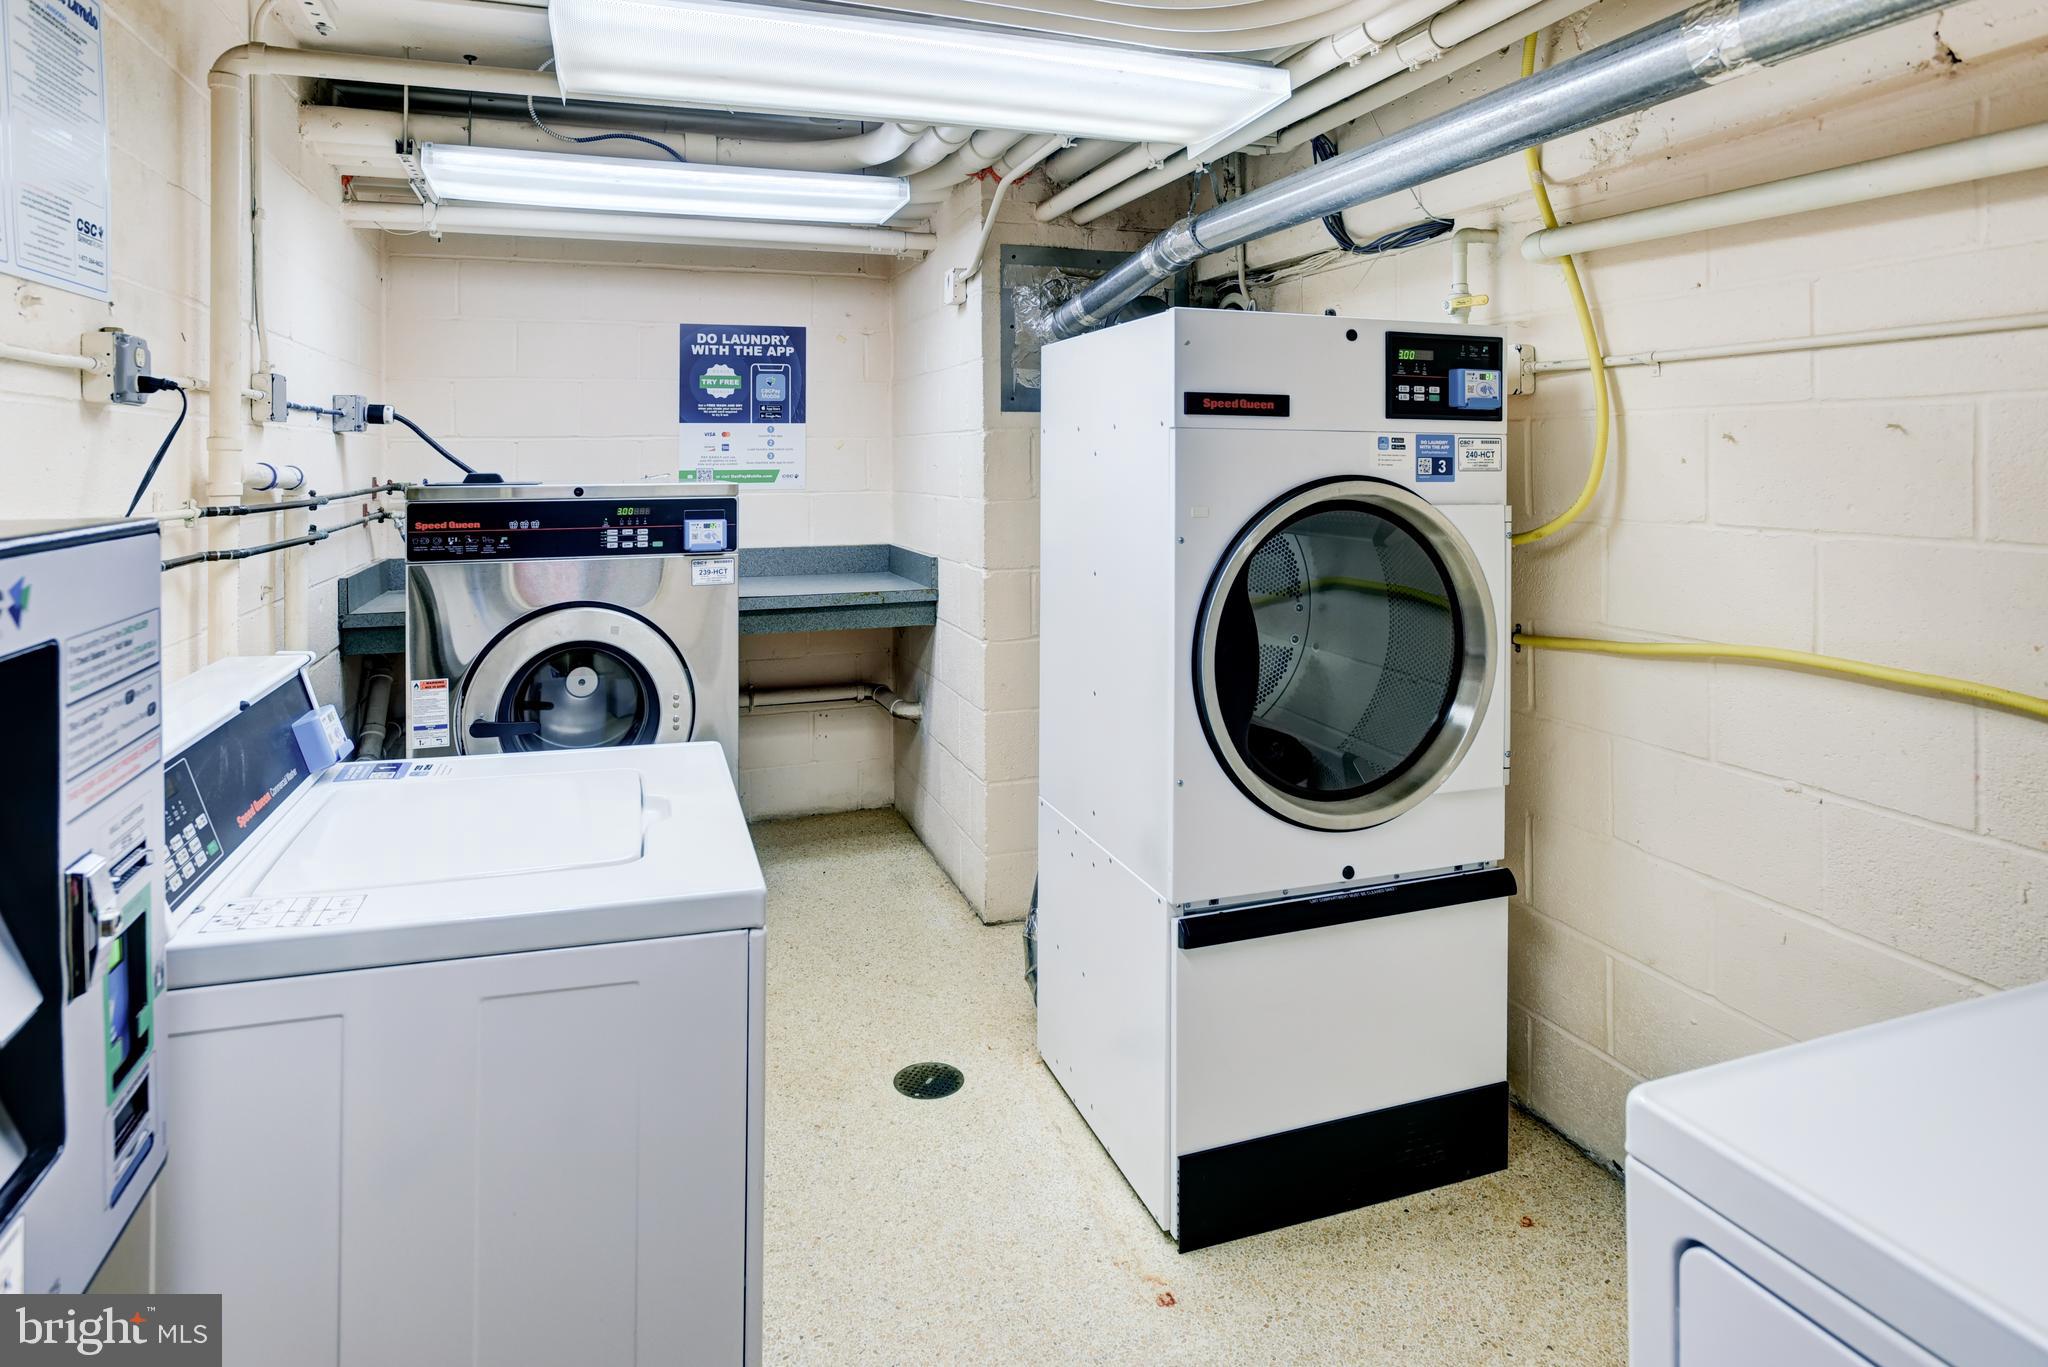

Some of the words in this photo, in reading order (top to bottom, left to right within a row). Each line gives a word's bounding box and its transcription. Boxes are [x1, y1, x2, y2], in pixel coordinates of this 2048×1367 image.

[76, 218, 97, 237] CSC
[697, 333, 718, 344] DO
[722, 334, 790, 346] LAUNDRY
[691, 345, 730, 355] WITH
[734, 345, 762, 356] THE
[767, 346, 795, 357] APP
[701, 378, 718, 386] TRY
[720, 378, 740, 386] FREE
[1203, 398, 1238, 410] Speed
[1239, 398, 1275, 410] Queen
[1438, 459, 1447, 473] 3
[415, 522, 447, 531] Speed
[448, 520, 481, 529] Queen
[699, 568, 728, 576] 239-HCT
[237, 803, 257, 829] Speed
[253, 791, 273, 812] Queen
